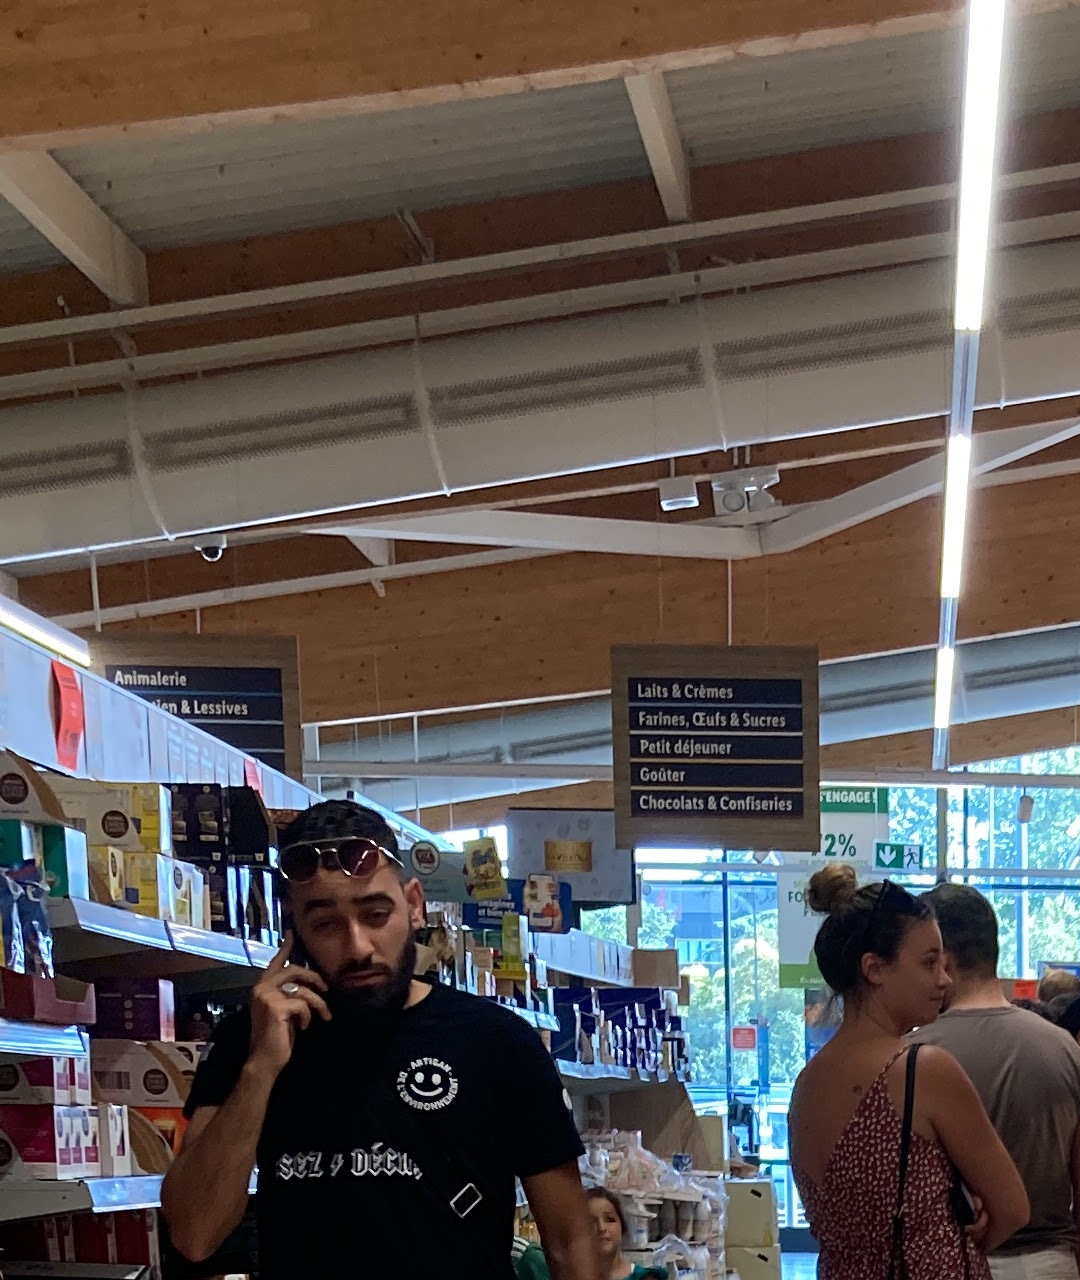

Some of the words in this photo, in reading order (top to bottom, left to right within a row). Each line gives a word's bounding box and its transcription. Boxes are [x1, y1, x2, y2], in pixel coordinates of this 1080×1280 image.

[114, 670, 187, 687] Animalerie
[637, 683, 668, 698] Laits
[672, 684, 682, 698] &
[684, 683, 733, 699] Crèmes
[180, 699, 192, 714] &
[194, 700, 248, 715] Lessives
[638, 711, 690, 729] Farines,
[692, 711, 727, 728] Œufs
[729, 713, 740, 728] &
[742, 713, 786, 728] Sucres
[640, 739, 671, 754] Petit
[673, 739, 732, 758] déjeuner
[639, 767, 686, 782] Goûter
[639, 795, 704, 811] Chocolats
[707, 796, 718, 811] &
[720, 796, 793, 812] Confiseries
[410, 1057, 452, 1073] ARTISAN
